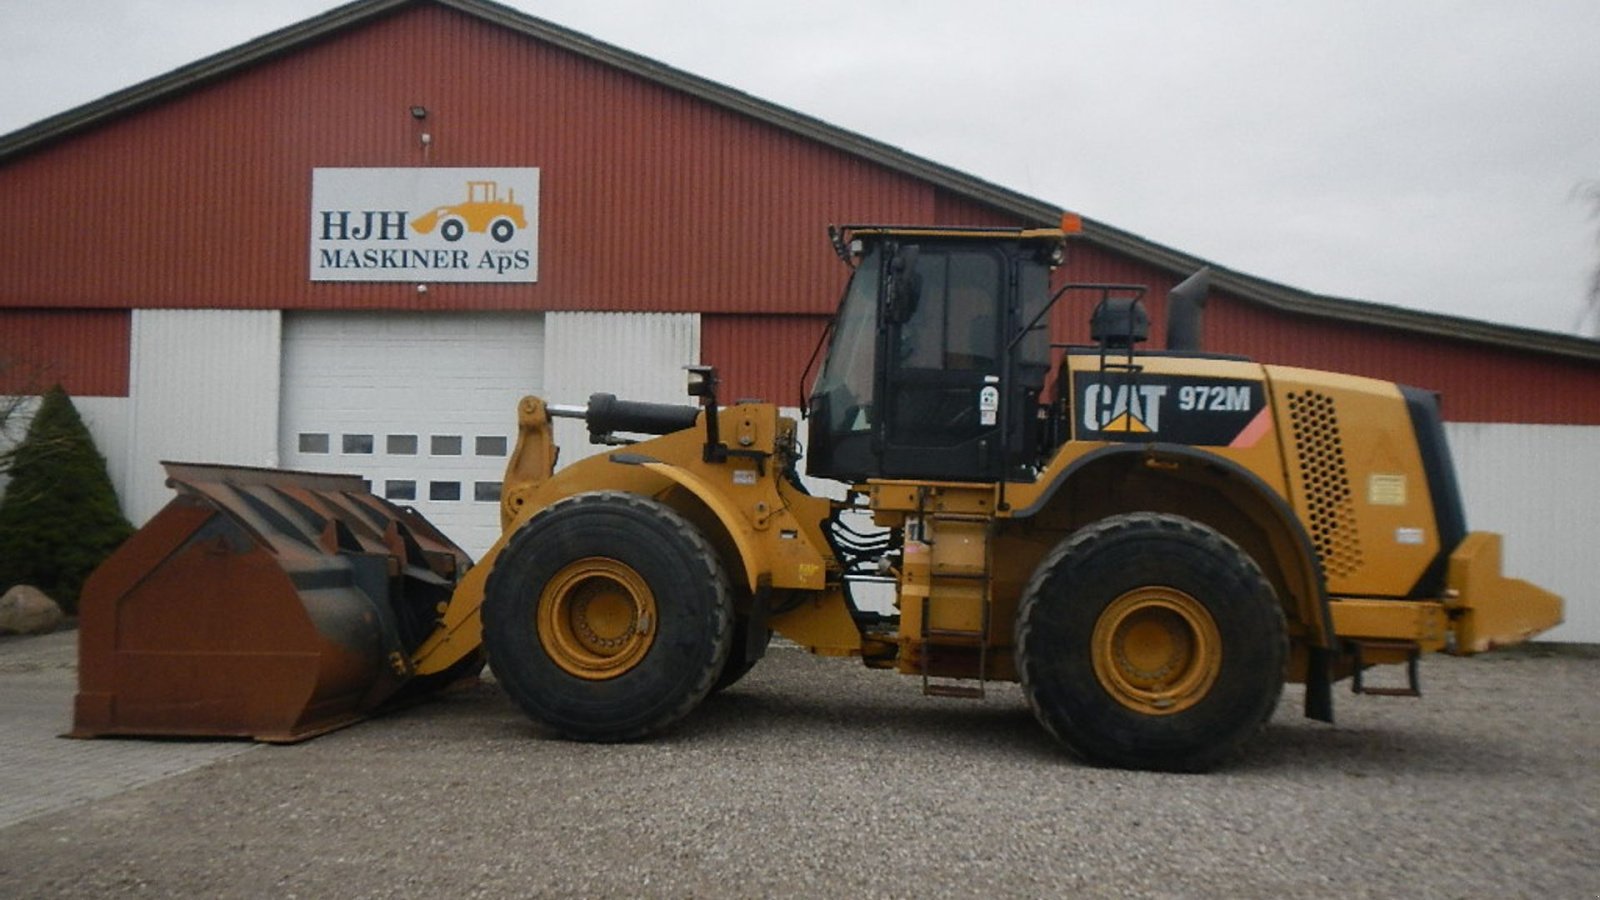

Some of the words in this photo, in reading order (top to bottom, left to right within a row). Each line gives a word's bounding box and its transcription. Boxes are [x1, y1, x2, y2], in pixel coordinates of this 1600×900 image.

[319, 211, 408, 240] HJH
[319, 249, 469, 269] MASKINER
[477, 249, 530, 274] ApS
[1084, 383, 1167, 433] CAT
[1178, 386, 1250, 411] 972M
